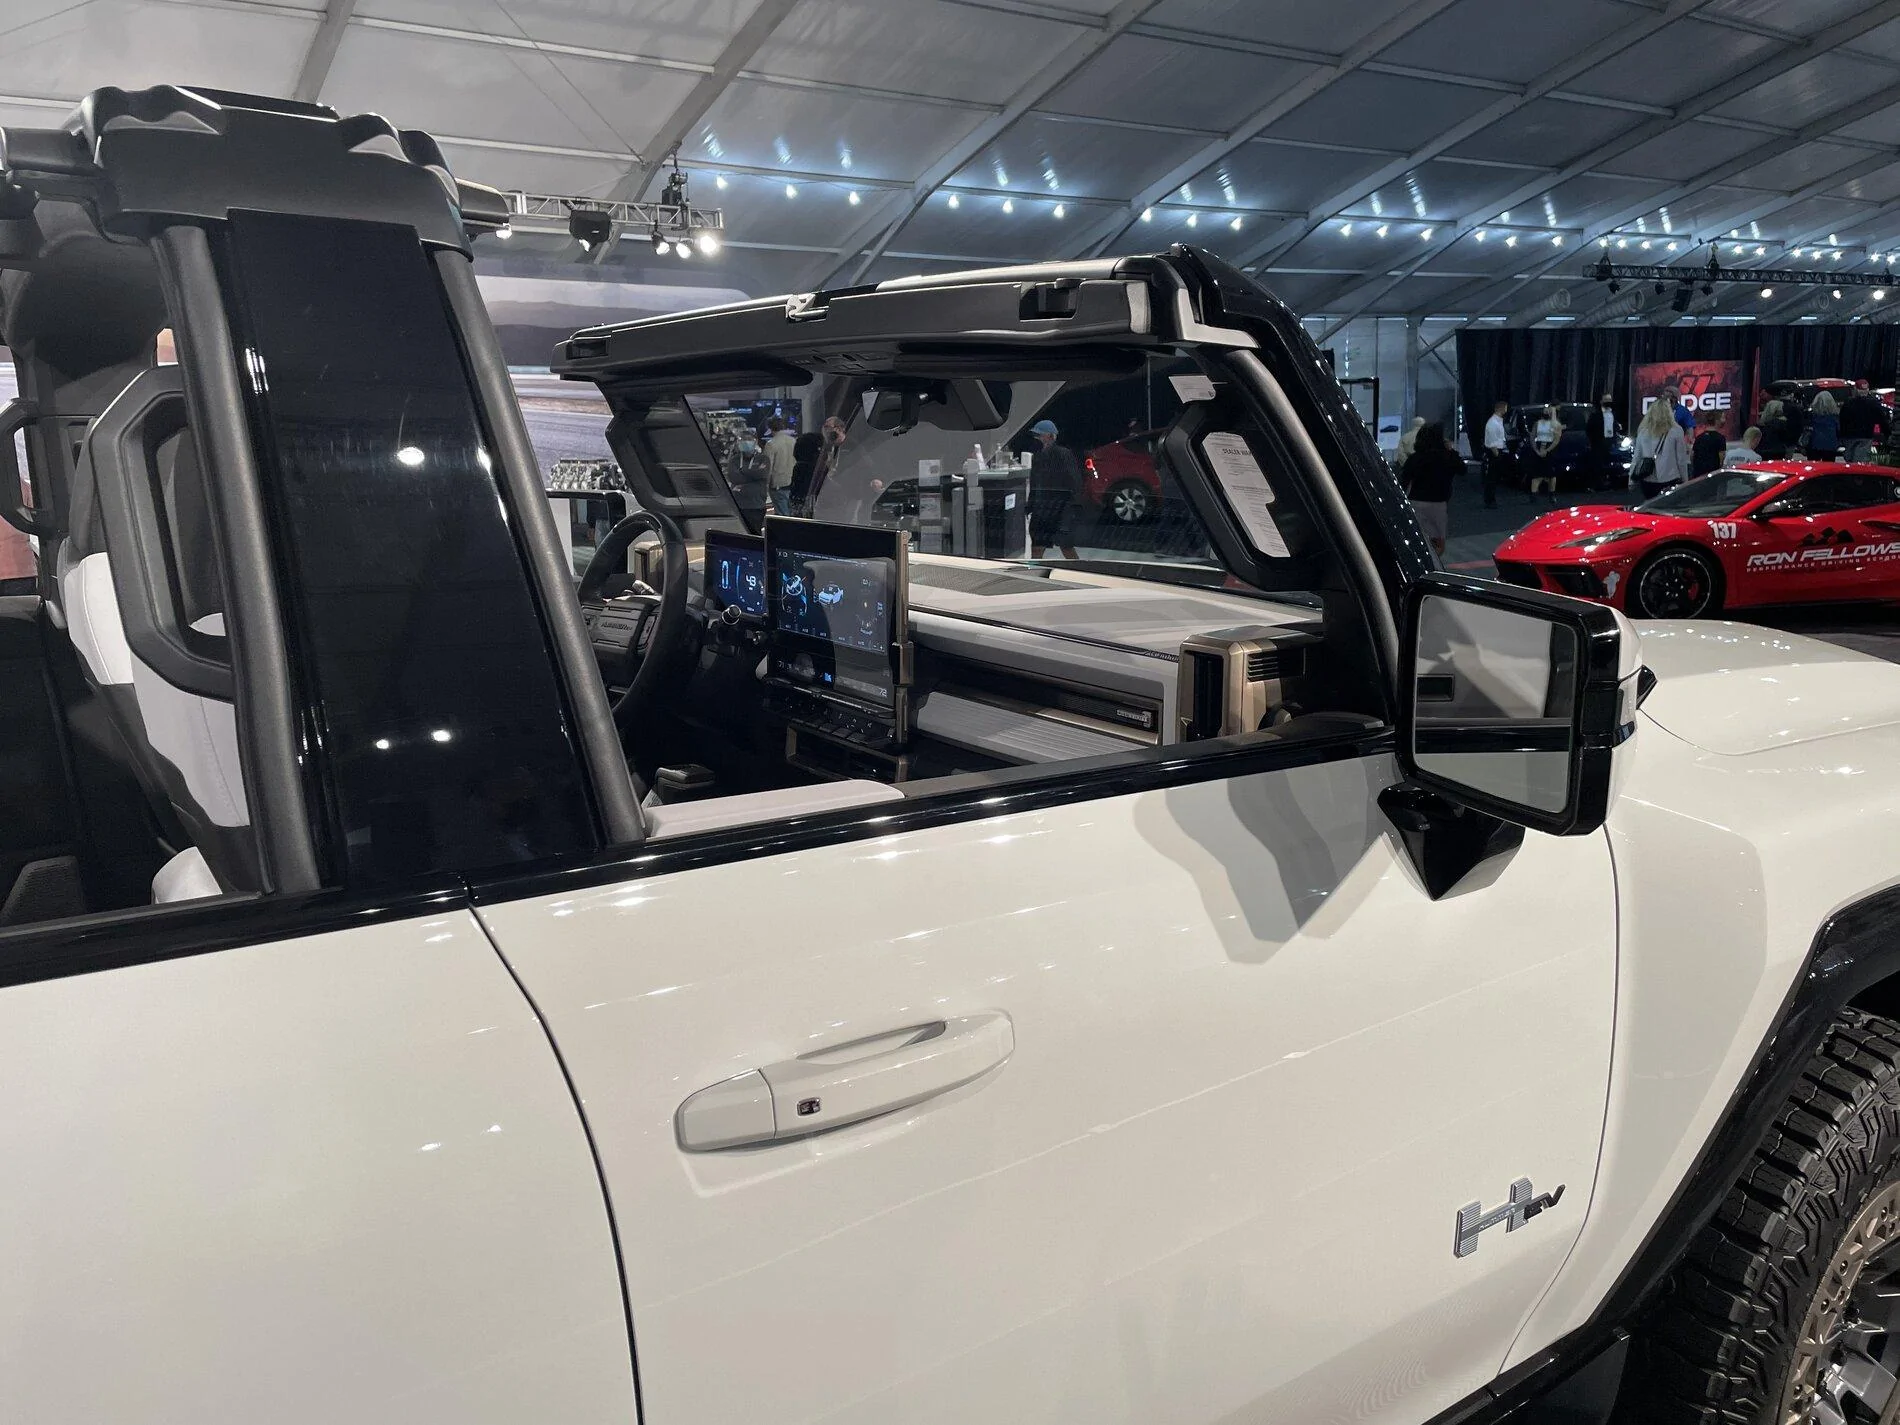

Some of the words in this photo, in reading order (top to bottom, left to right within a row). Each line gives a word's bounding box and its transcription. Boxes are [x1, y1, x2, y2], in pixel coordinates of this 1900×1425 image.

[1642, 392, 1731, 415] DGE
[1710, 521, 1737, 539] 137
[1747, 551, 1798, 567] RON
[1800, 542, 1900, 562] FELLOWS
